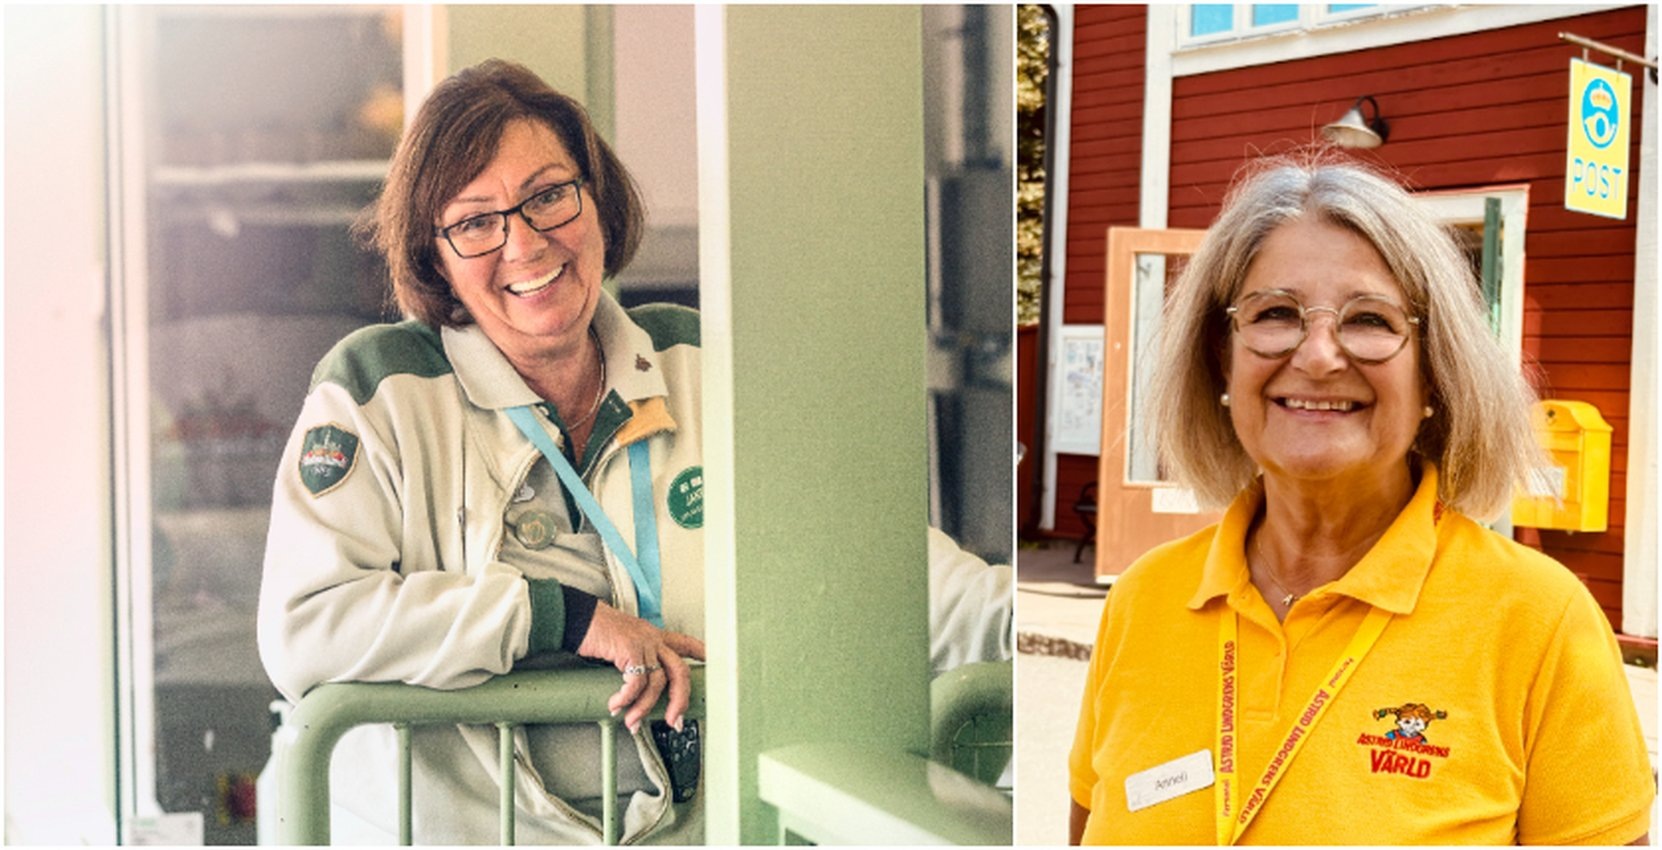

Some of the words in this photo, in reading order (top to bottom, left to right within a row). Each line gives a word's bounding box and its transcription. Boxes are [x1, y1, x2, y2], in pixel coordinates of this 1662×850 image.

[1573, 158, 1622, 200] POST
[1300, 689, 1330, 727] ASTRID
[1220, 735, 1234, 774] ASTRID
[1261, 725, 1306, 787] LINDGRENS
[1357, 732, 1393, 748] ASTRID
[1370, 749, 1431, 779] VÄRLD
